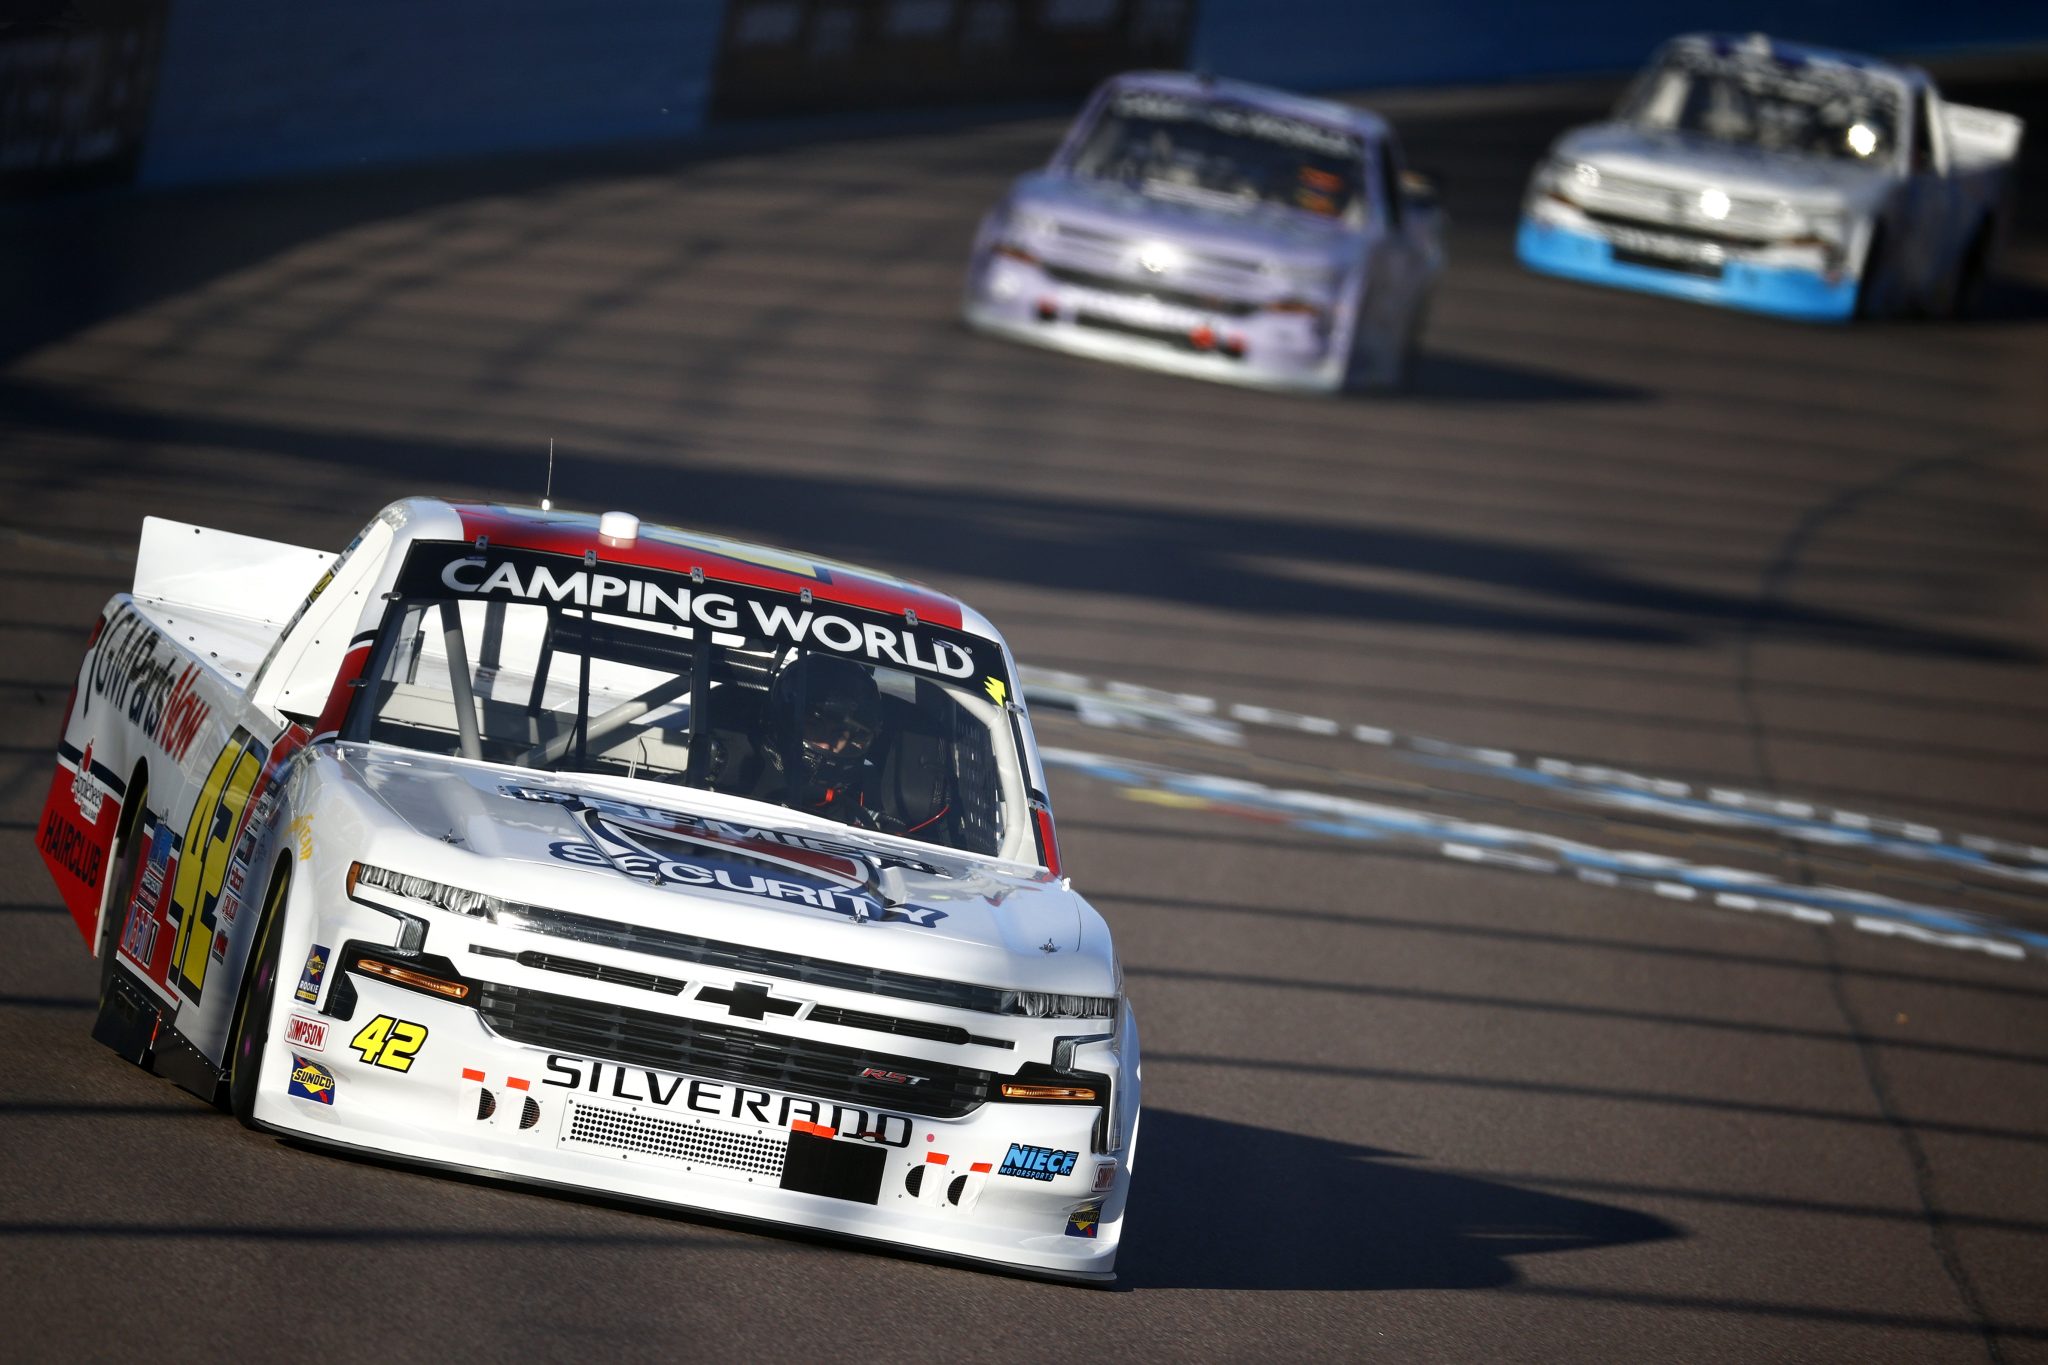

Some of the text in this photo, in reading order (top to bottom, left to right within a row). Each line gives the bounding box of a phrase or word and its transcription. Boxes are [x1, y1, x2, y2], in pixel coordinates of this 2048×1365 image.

[441, 557, 738, 629] CAMPING
[747, 600, 975, 680] WORLD
[168, 730, 266, 1000] 42
[549, 840, 949, 928] SECURITY
[299, 980, 319, 995] ROOKIE
[286, 1018, 325, 1047] SIMPSON
[349, 1015, 428, 1073] 42
[293, 1069, 333, 1089] SUNOCO
[858, 1066, 930, 1086] RST
[541, 1053, 914, 1149] SILVERADO
[1000, 1166, 1054, 1181] MOTORSPORTS
